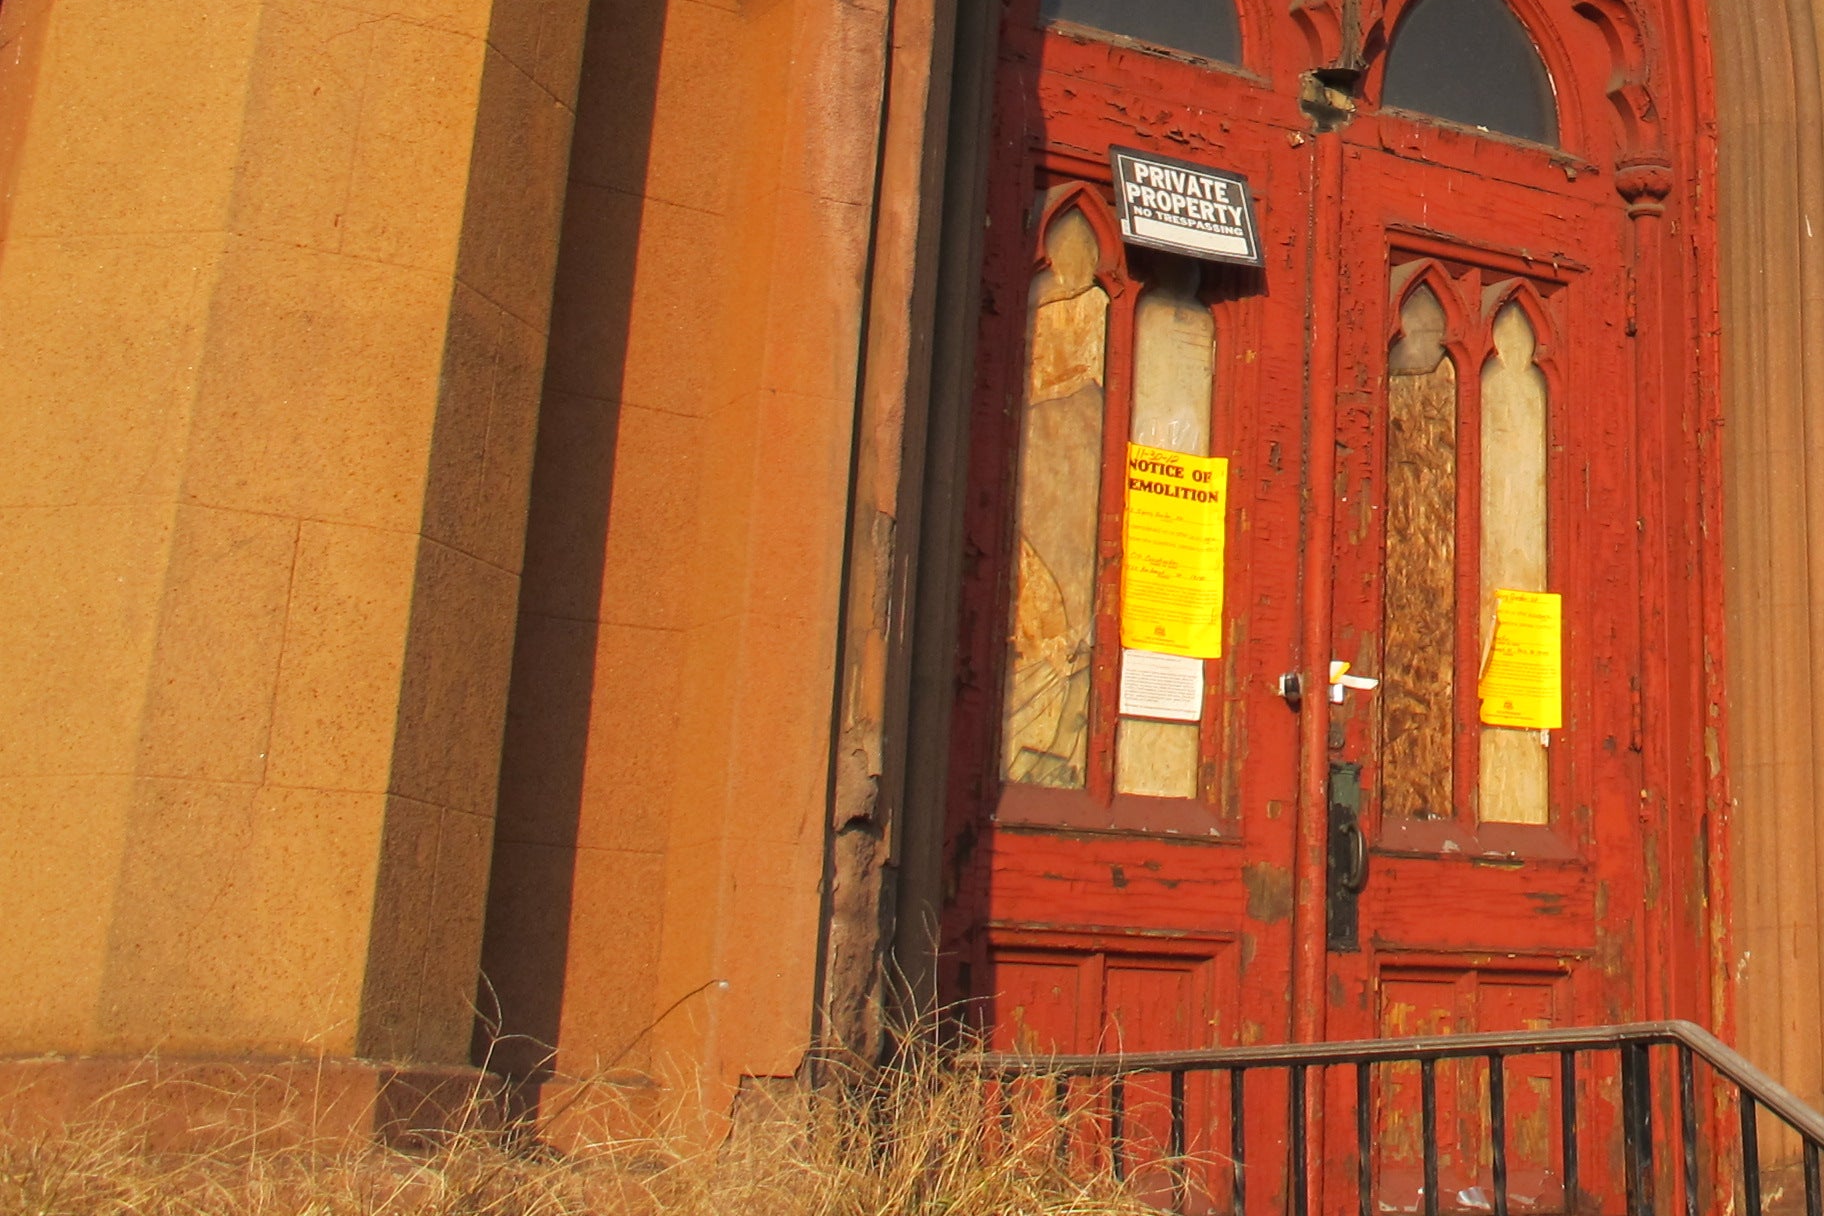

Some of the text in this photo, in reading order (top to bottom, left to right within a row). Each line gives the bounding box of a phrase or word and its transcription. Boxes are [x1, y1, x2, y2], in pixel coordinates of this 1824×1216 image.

[1133, 162, 1230, 204] PRIVATE
[1126, 181, 1243, 227] PROPERTY
[1133, 205, 1244, 236] NO TRESPASSING
[1129, 458, 1213, 484] NOTICE OF
